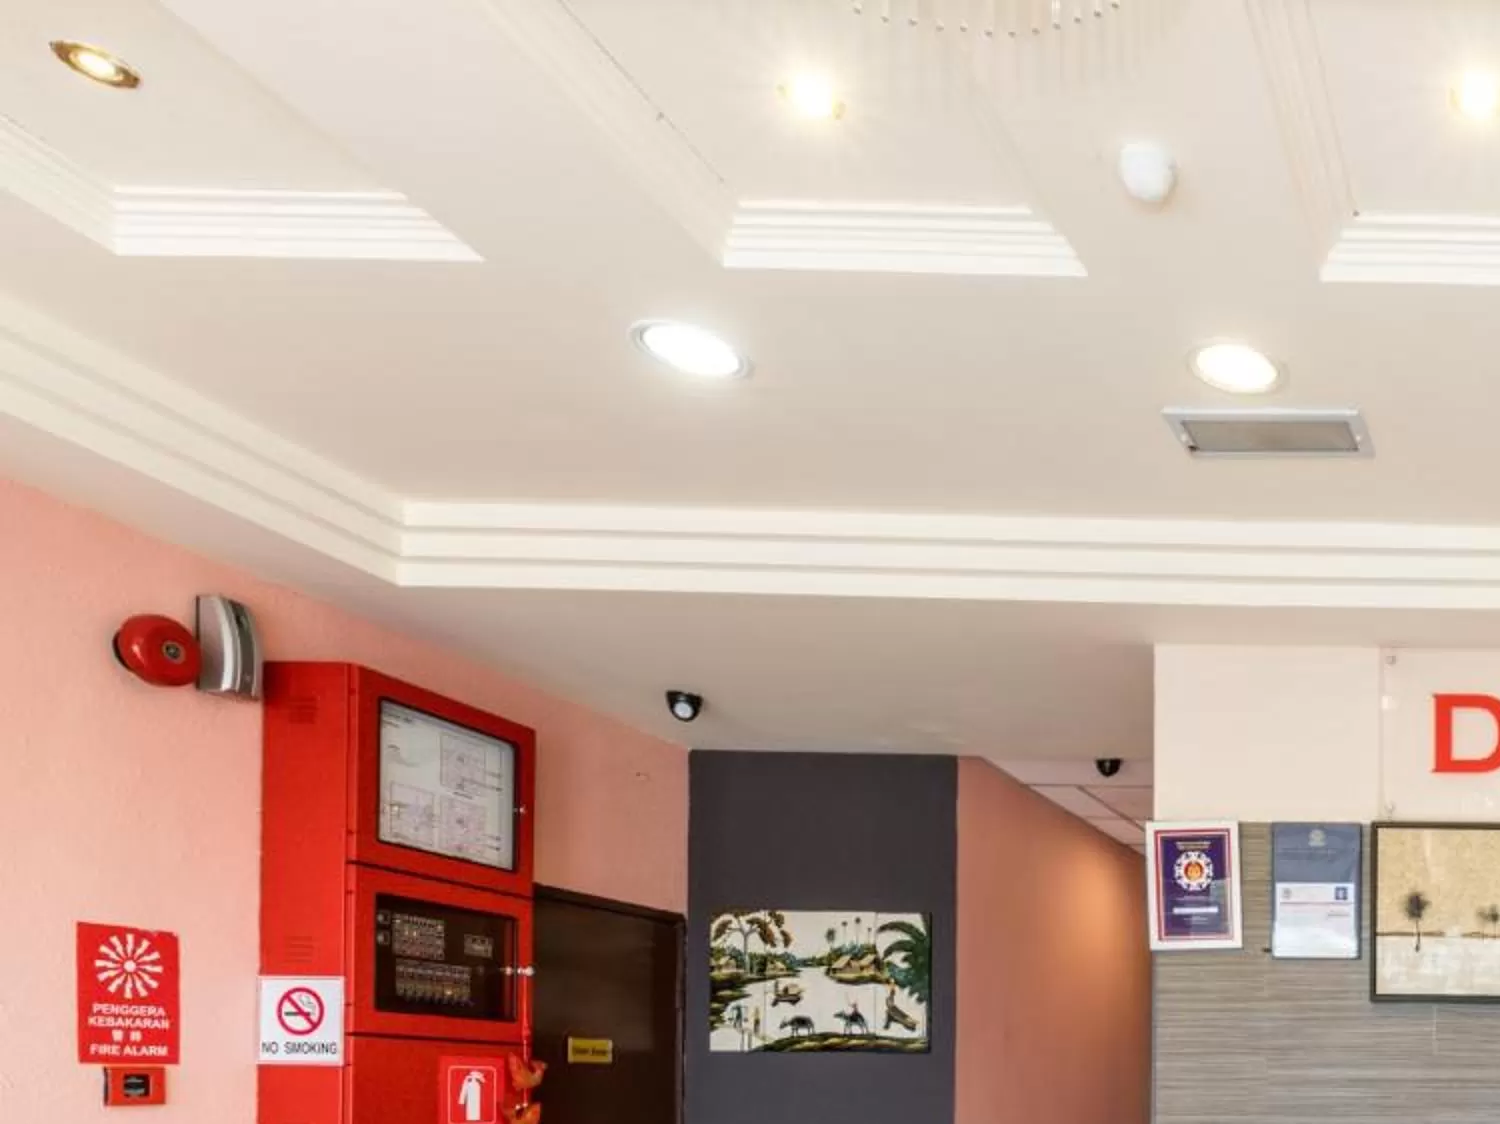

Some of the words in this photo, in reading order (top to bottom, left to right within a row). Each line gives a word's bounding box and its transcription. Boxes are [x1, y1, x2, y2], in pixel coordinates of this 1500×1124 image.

[92, 1003, 166, 1017] PENGGERA
[87, 1015, 169, 1030] KEBAKARAN
[89, 1044, 121, 1056] FIRE
[123, 1045, 168, 1057] ALARM
[261, 1041, 279, 1054] NO
[284, 1041, 337, 1055] SMOKING
